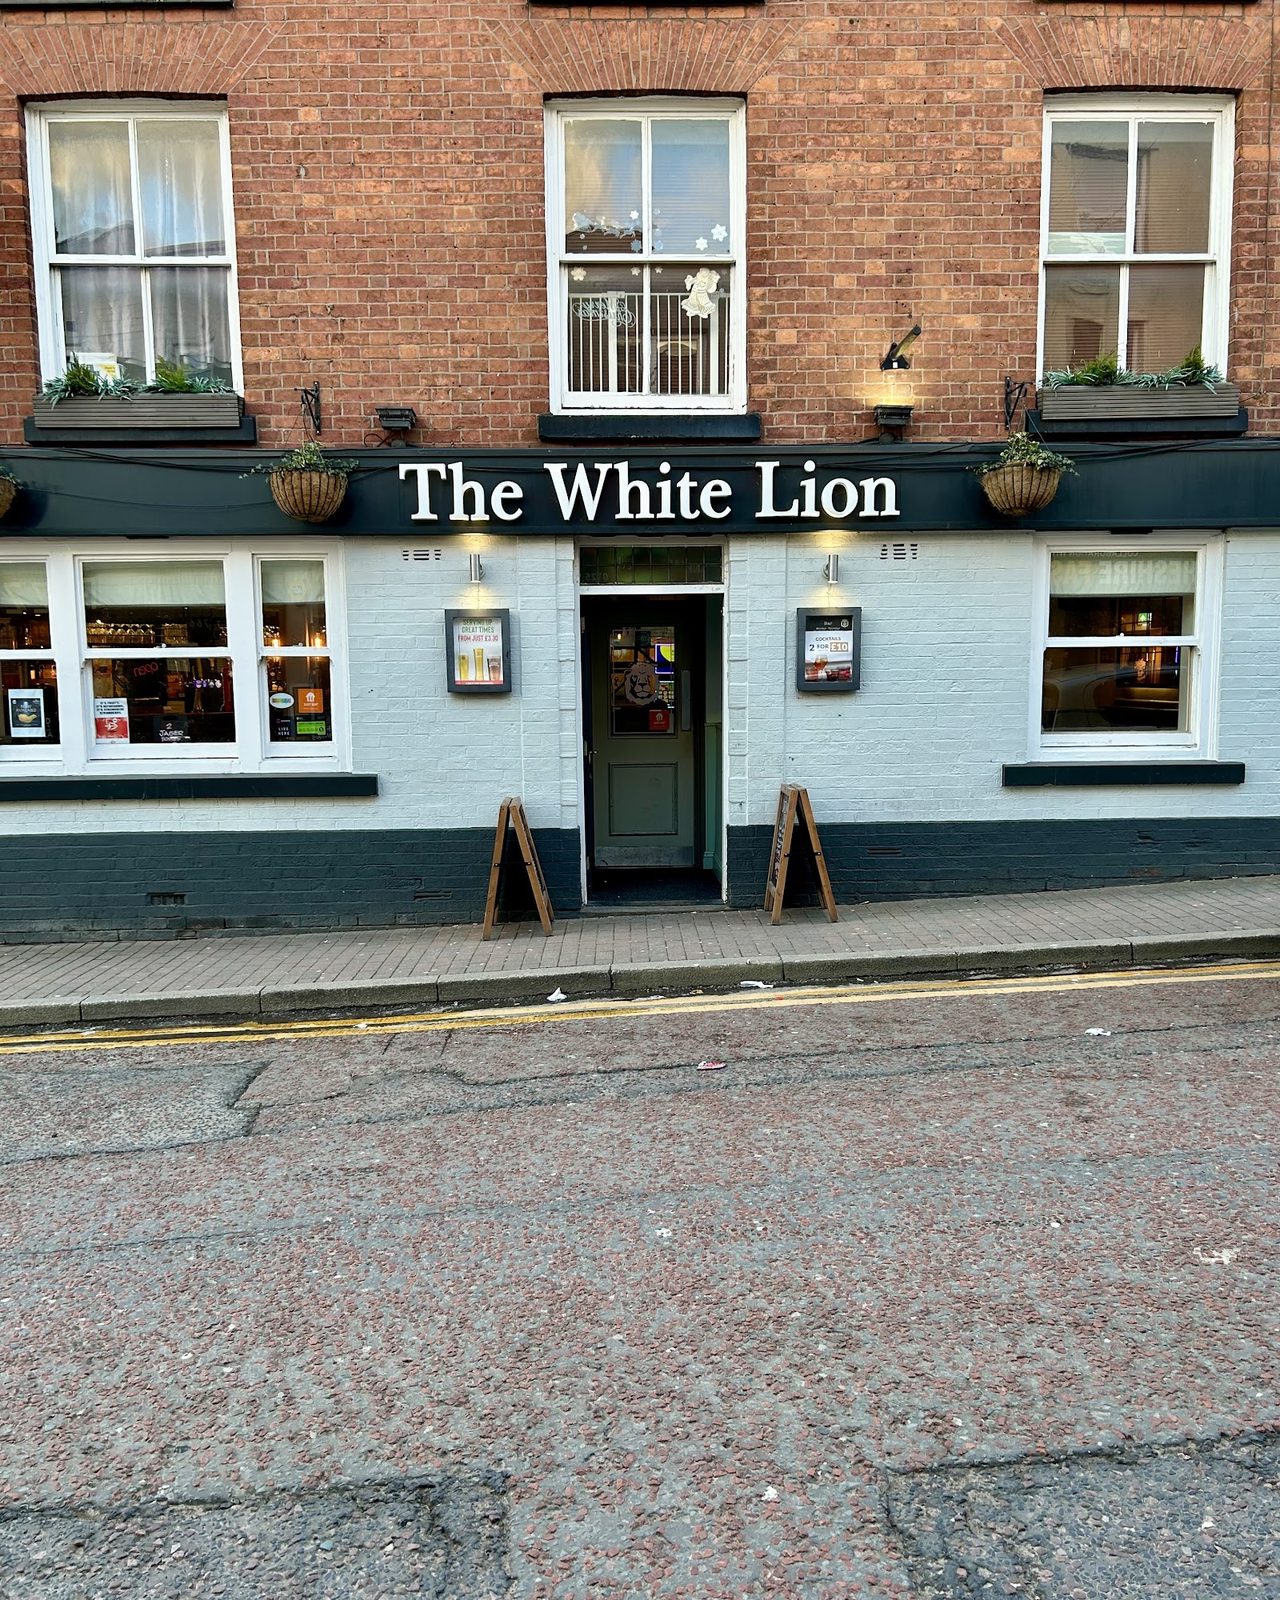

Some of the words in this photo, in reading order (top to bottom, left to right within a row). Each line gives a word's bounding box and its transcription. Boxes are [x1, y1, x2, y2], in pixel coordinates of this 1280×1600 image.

[399, 462, 524, 521] The
[543, 460, 732, 521] White
[754, 460, 900, 519] Lion
